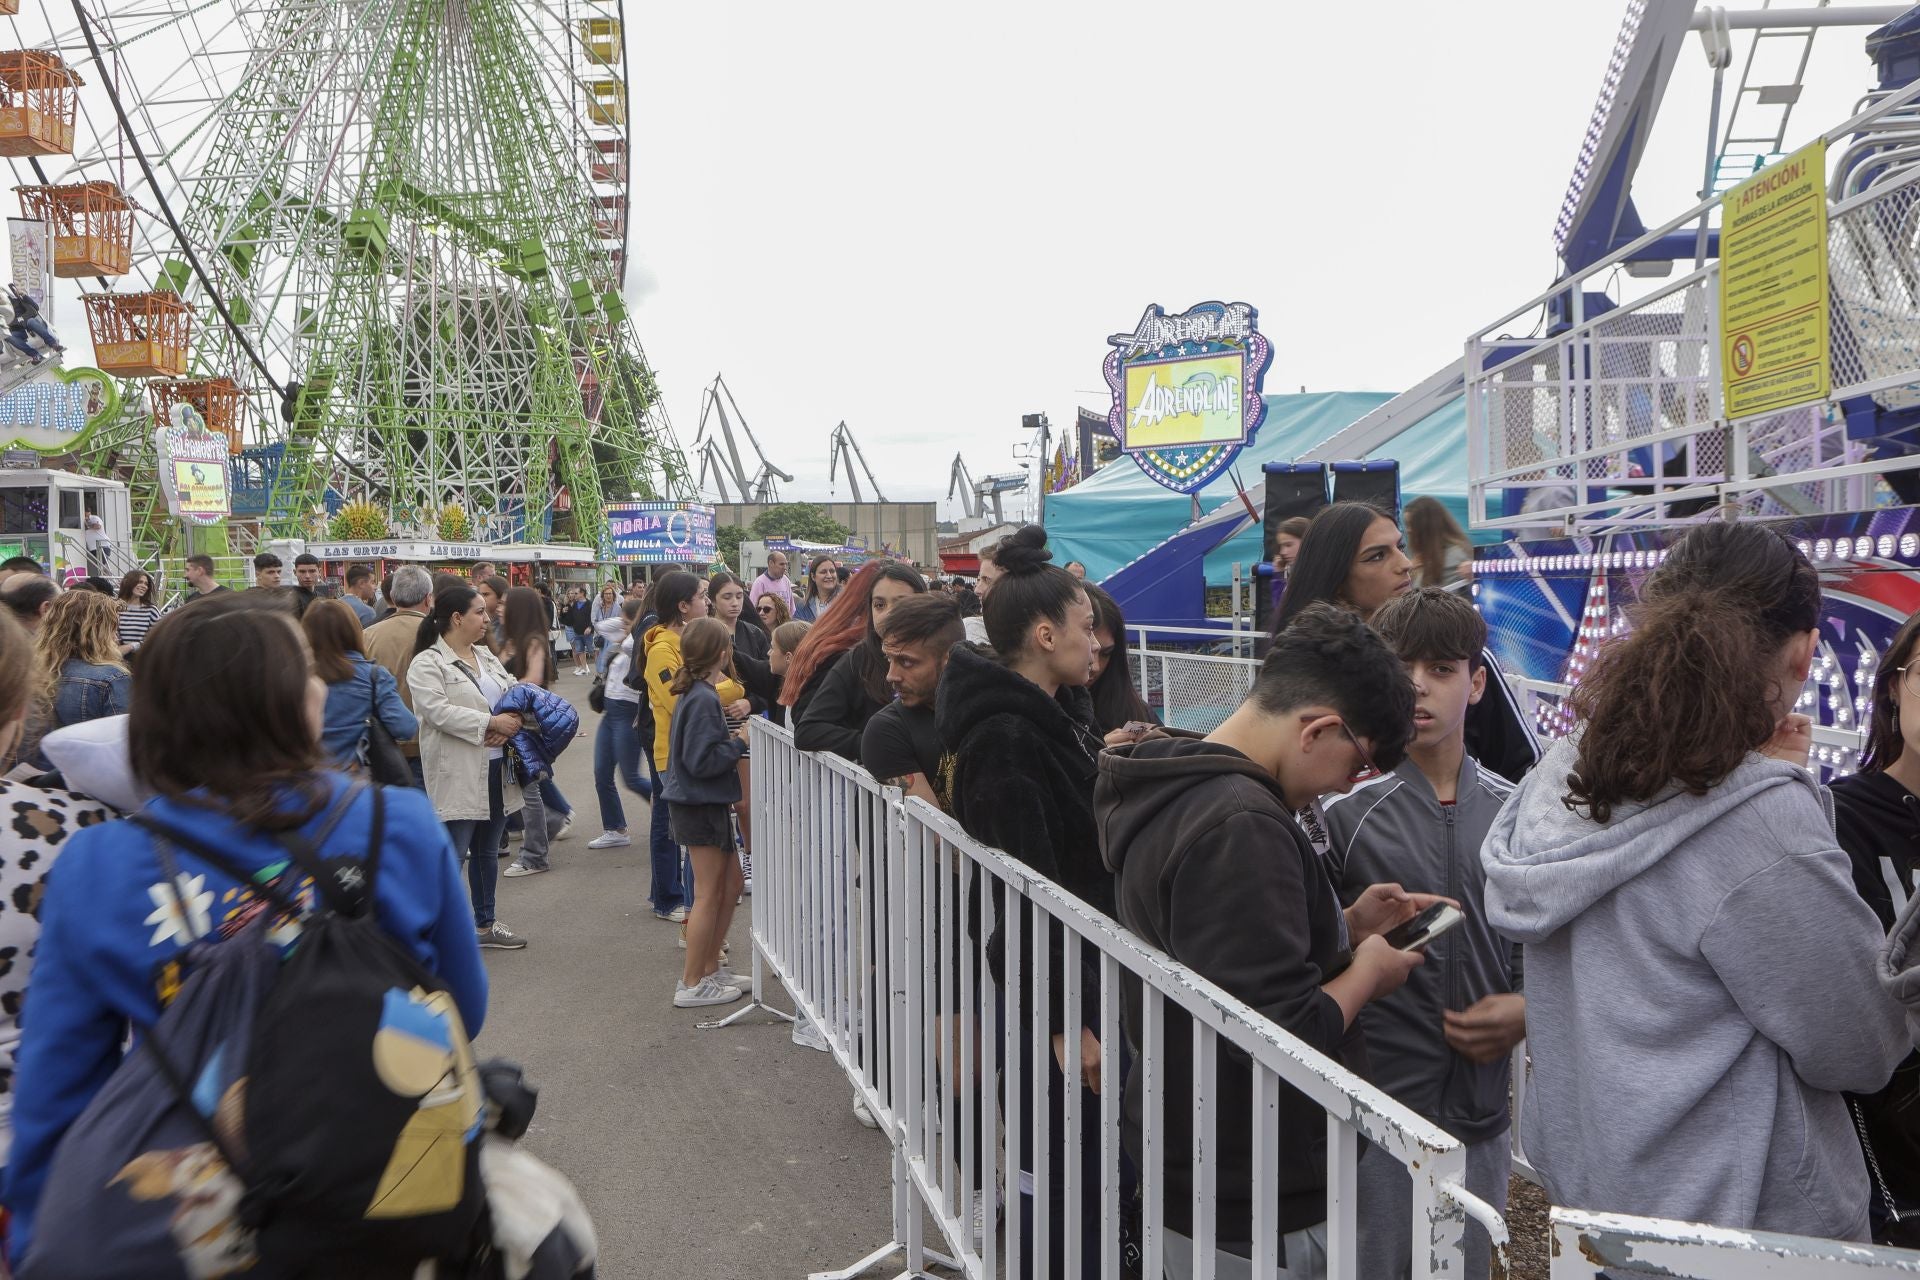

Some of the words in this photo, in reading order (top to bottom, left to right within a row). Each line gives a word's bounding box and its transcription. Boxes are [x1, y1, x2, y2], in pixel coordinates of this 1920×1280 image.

[1116, 304, 1250, 356] ADRENALINE
[1128, 372, 1239, 428] ADRENALINE
[612, 515, 662, 536] NORIA
[324, 547, 349, 556] LAS
[430, 546, 449, 555] LAS
[616, 540, 661, 549] TAQUILLA
